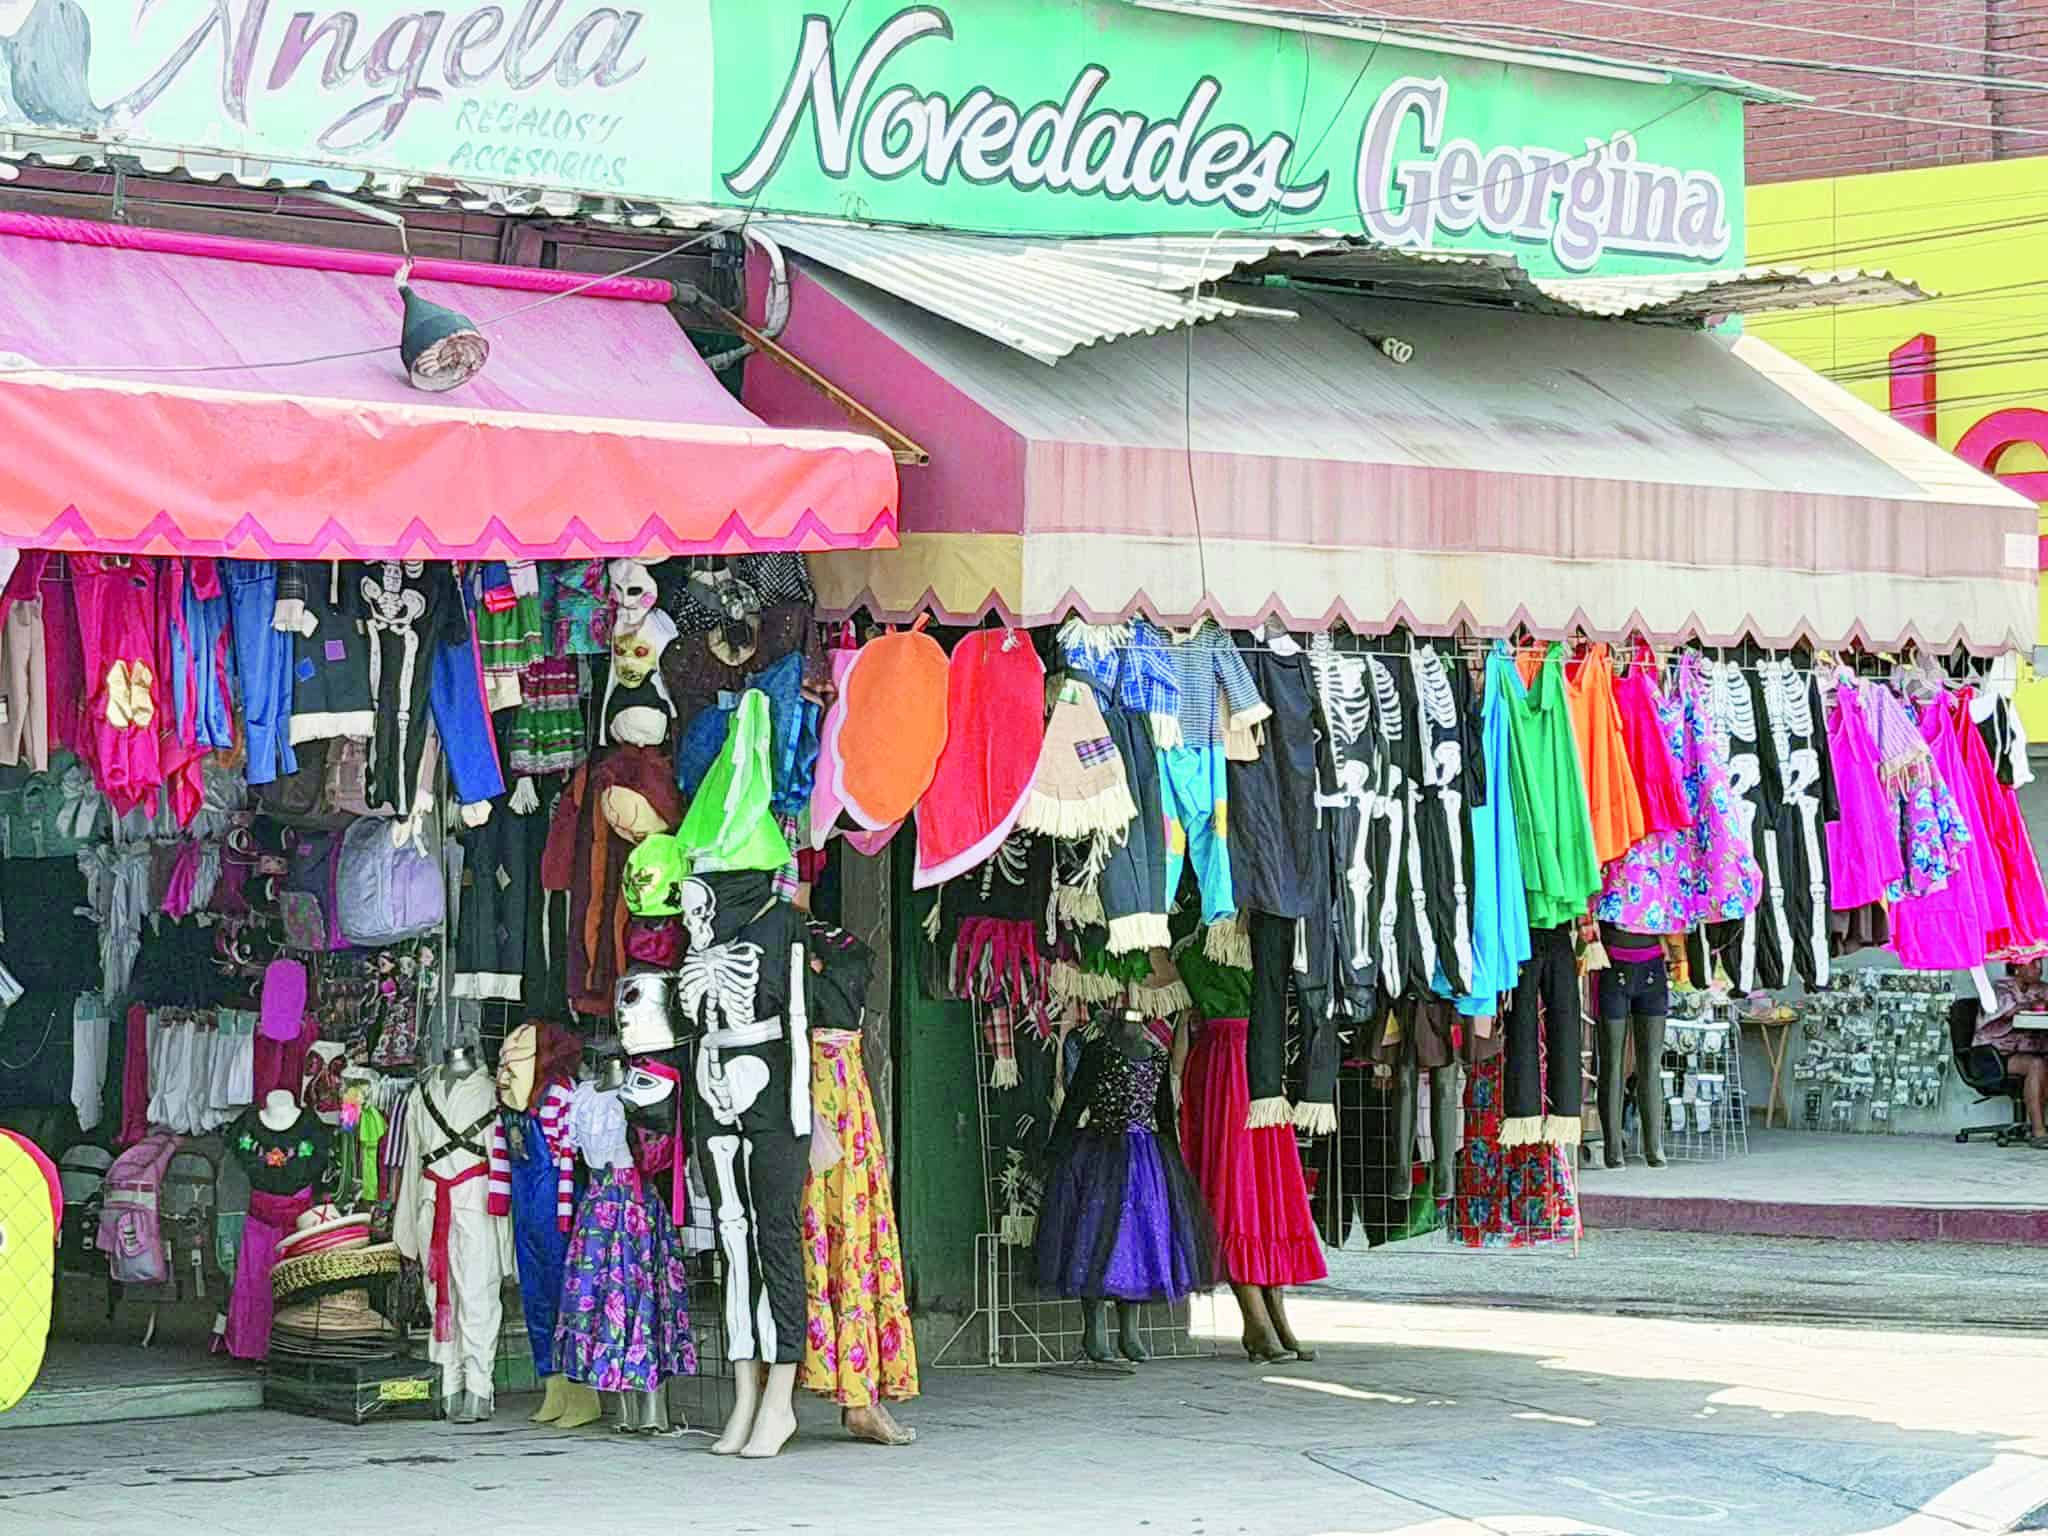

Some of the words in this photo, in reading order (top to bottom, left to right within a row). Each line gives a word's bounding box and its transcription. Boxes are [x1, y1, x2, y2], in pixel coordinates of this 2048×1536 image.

[100, 0, 648, 154] Angela
[456, 98, 594, 142] REGALOS
[448, 140, 627, 186] ACCESORIOS
[721, 6, 1330, 216] Novedades
[1355, 75, 1731, 272] Georgina
